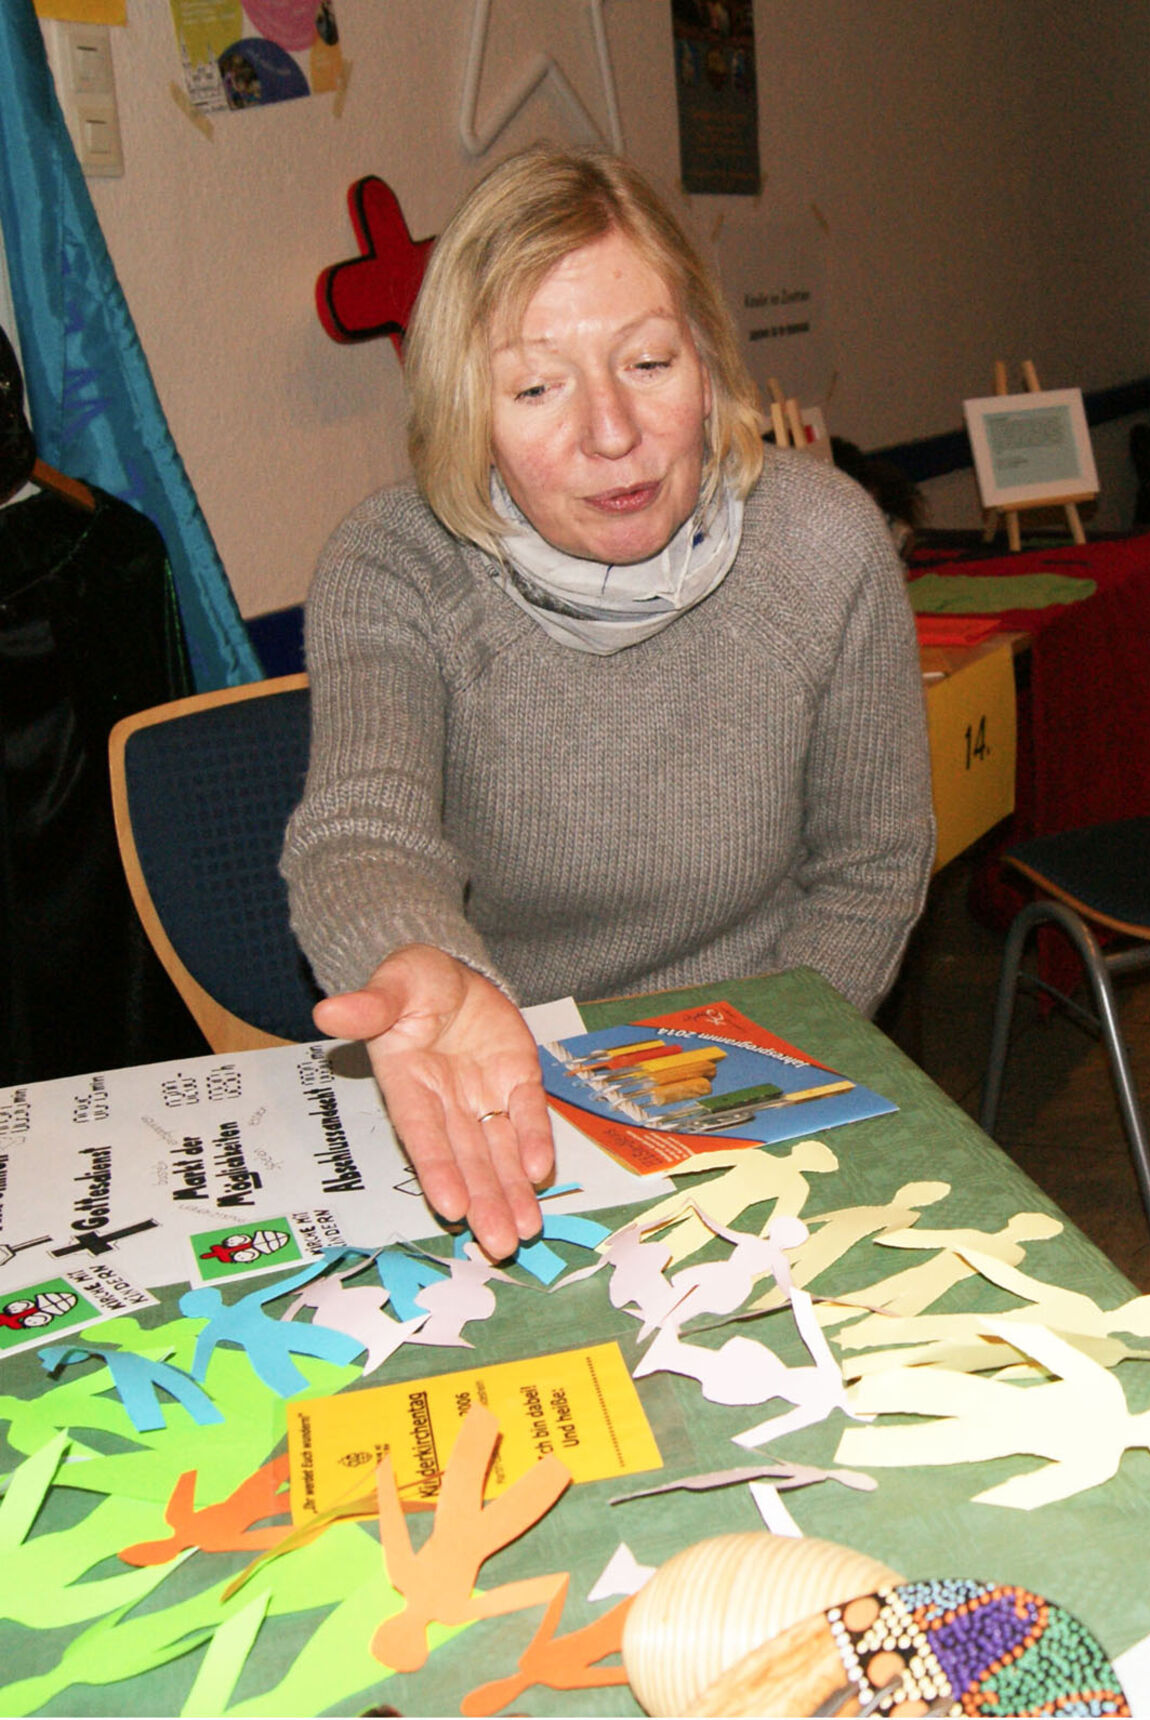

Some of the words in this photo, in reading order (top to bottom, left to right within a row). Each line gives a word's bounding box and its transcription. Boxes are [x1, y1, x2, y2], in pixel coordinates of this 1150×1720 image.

[657, 1027, 696, 1039] 2014
[697, 1032, 810, 1068] Jahresprogramm
[170, 1136, 204, 1155] der
[302, 1086, 366, 1193] Abschlussandacht
[172, 1159, 209, 1200] Markt
[211, 1121, 263, 1207] Möglichkeiten
[71, 1146, 112, 1231] Gottesdienst
[520, 1385, 544, 1418] dabei!
[550, 1387, 573, 1423] heiße:
[408, 1391, 441, 1499] Kinderkirchentag
[530, 1420, 550, 1439] bin
[557, 1424, 580, 1448] Und
[533, 1440, 554, 1460] ch
